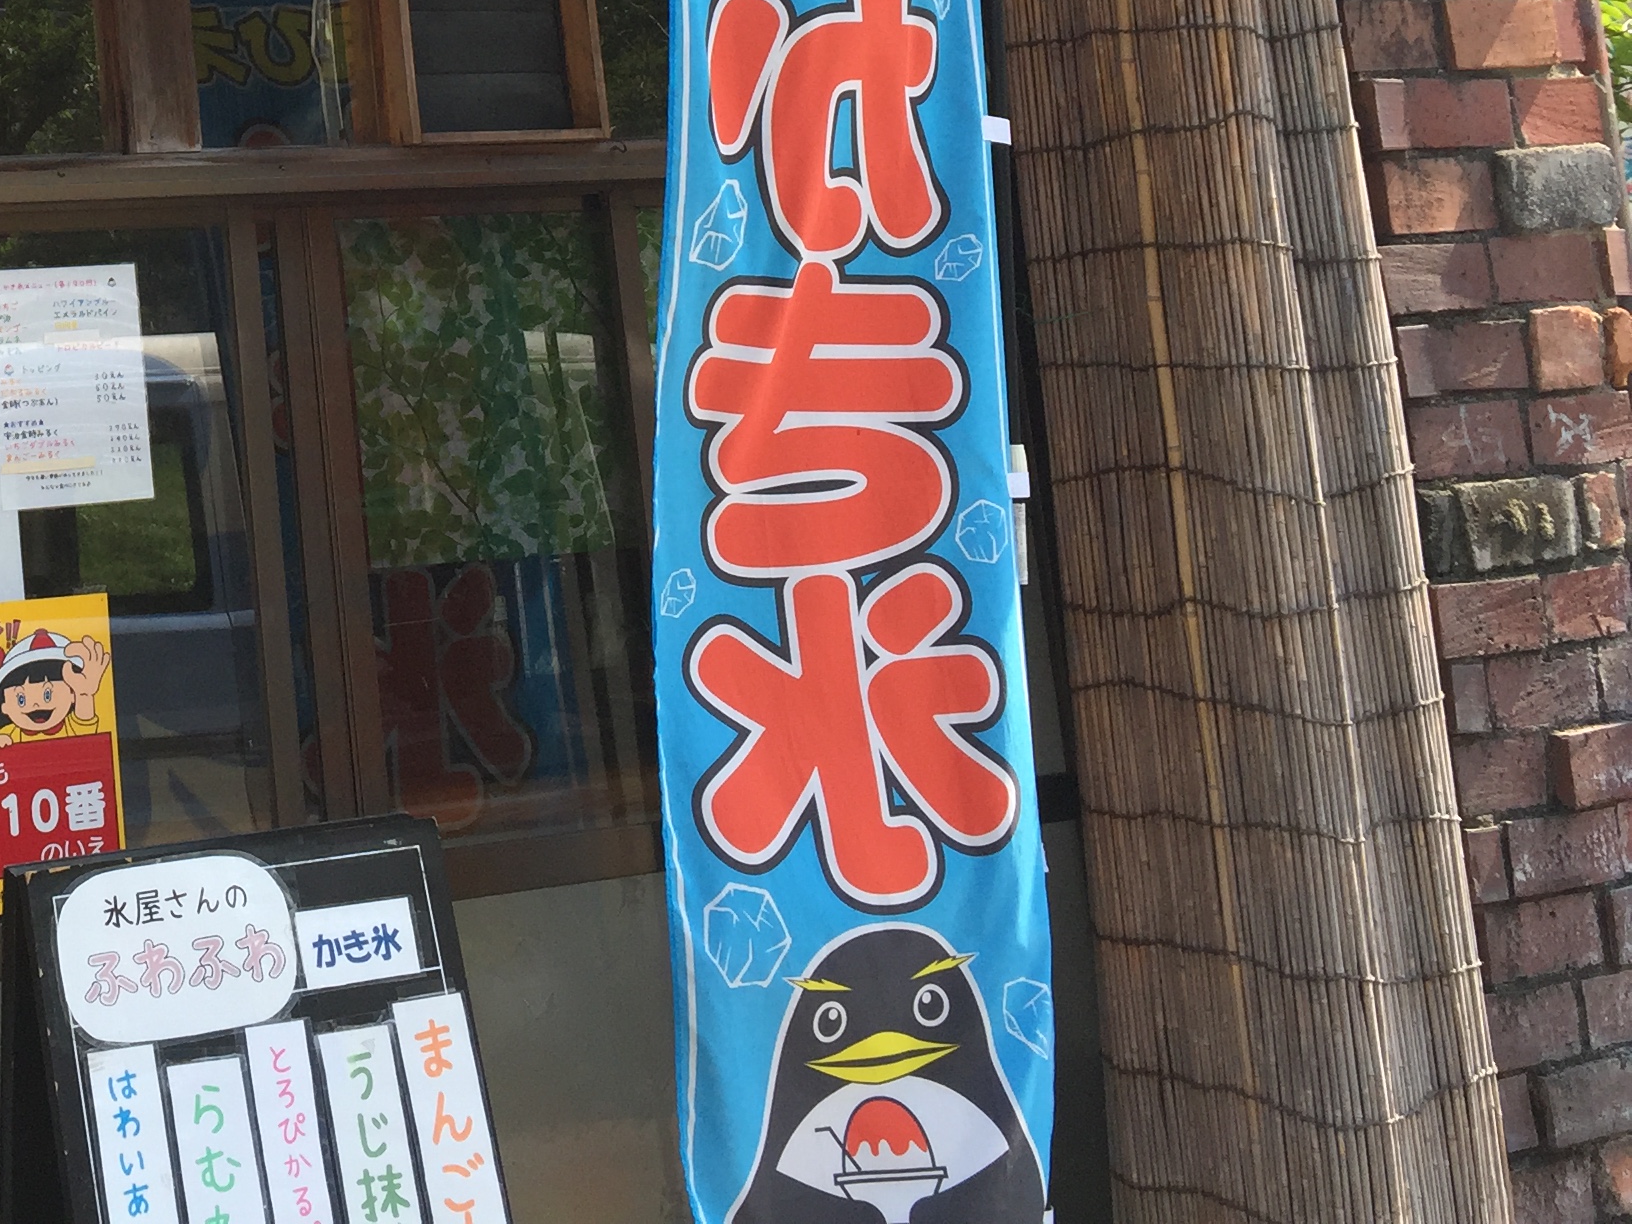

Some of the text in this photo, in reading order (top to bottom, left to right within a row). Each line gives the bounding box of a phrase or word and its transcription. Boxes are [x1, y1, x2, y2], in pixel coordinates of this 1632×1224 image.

[40, 836, 105, 861] のいえ
[102, 884, 249, 927] 氷屋さんの
[84, 923, 287, 1006] ふわふわ
[311, 923, 403, 969] かき氷
[269, 1046, 321, 1224] とろぴかる
